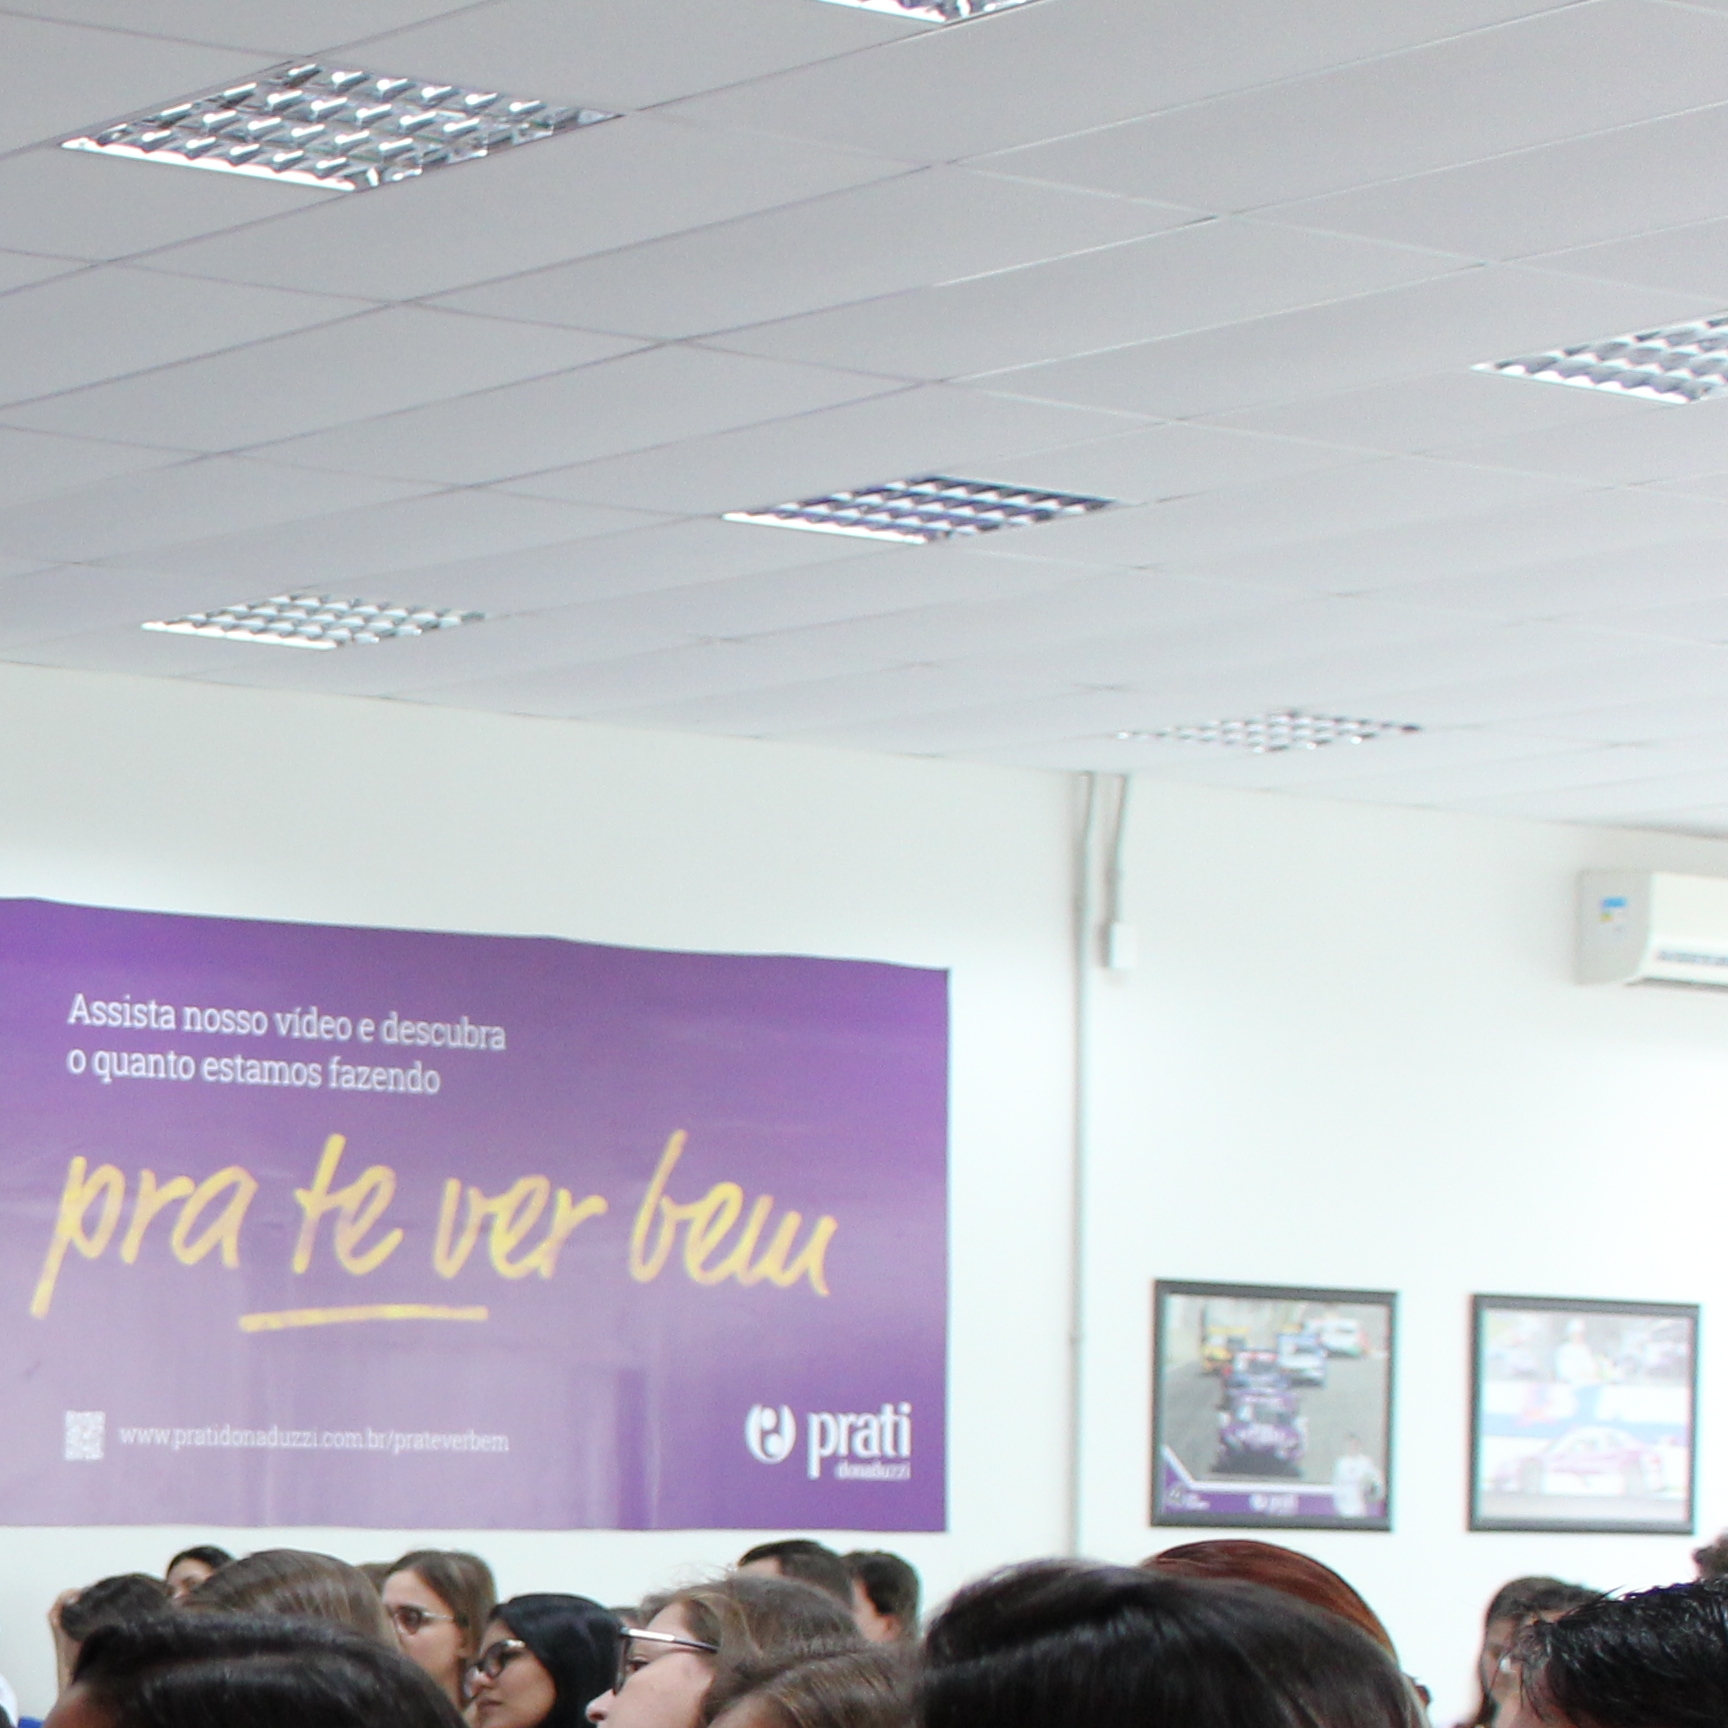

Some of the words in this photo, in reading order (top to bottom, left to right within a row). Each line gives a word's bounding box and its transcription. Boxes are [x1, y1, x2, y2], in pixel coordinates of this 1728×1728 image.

[67, 993, 176, 1030] Assista
[183, 1005, 268, 1035] nosso
[275, 1006, 352, 1040] vídeo
[358, 1017, 375, 1041] e
[382, 1011, 507, 1051] descubra
[68, 1049, 87, 1074] o
[94, 1050, 196, 1084] quanto
[201, 1054, 322, 1088] estamos
[329, 1056, 441, 1094] fazendo
[29, 1155, 258, 1319] pra
[293, 1133, 405, 1275] te
[432, 1175, 608, 1281] ver
[629, 1129, 840, 1297] bem
[118, 1423, 510, 1455] www.pratidonaduzzi.com.br/prateverbem
[807, 1401, 912, 1481] prati
